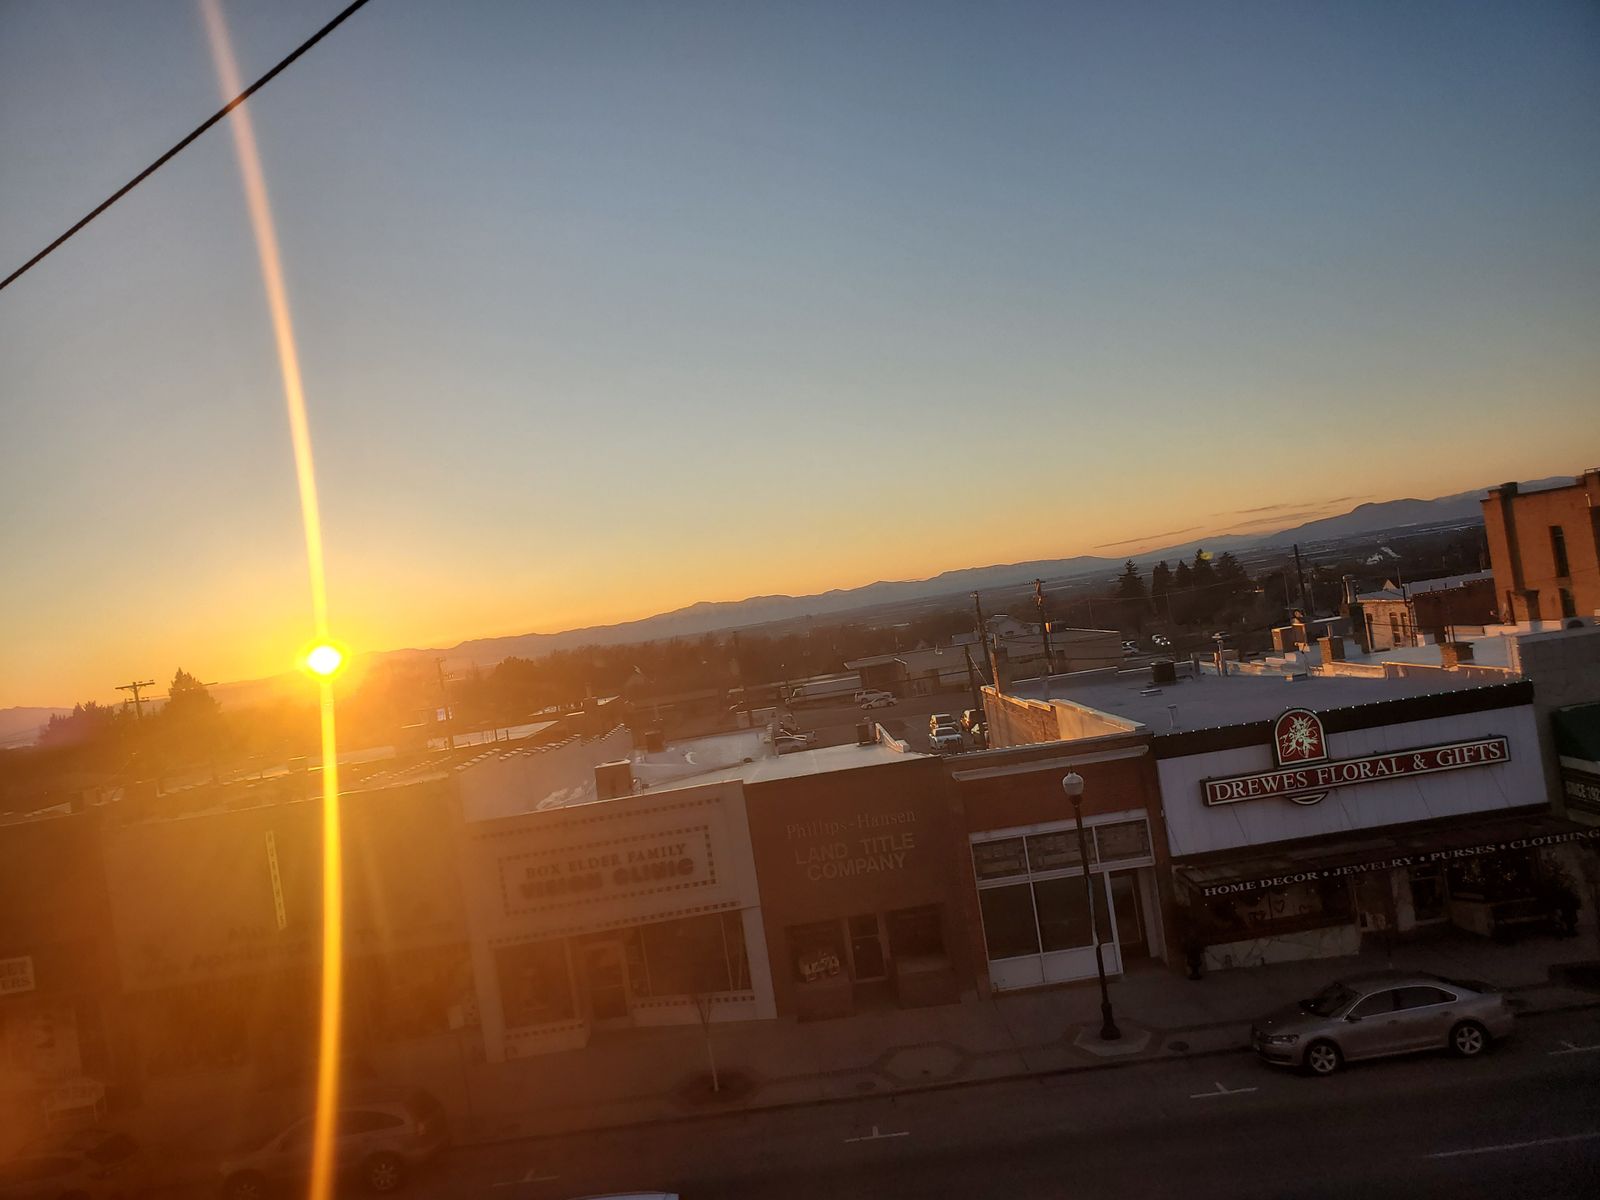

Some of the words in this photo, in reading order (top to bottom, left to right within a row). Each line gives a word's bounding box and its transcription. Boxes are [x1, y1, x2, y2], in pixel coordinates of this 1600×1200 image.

[1214, 770, 1309, 801] DREWES
[1317, 756, 1405, 785] FLORAL
[1413, 753, 1429, 771] &
[1436, 741, 1501, 767] GIFTS
[525, 863, 561, 880] BOX
[568, 853, 622, 873] ELDER
[628, 842, 688, 864] FAMILY
[795, 842, 849, 866] LAND
[859, 832, 916, 855] TITLE
[807, 852, 907, 881] COMPANY
[1203, 880, 1257, 897] HOME
[1260, 870, 1319, 889] DECOR
[1332, 856, 1414, 877] JEWELRY
[1430, 843, 1497, 863] PURSES
[1510, 828, 1600, 850] CLOTHING
[612, 857, 695, 886] CLINIC
